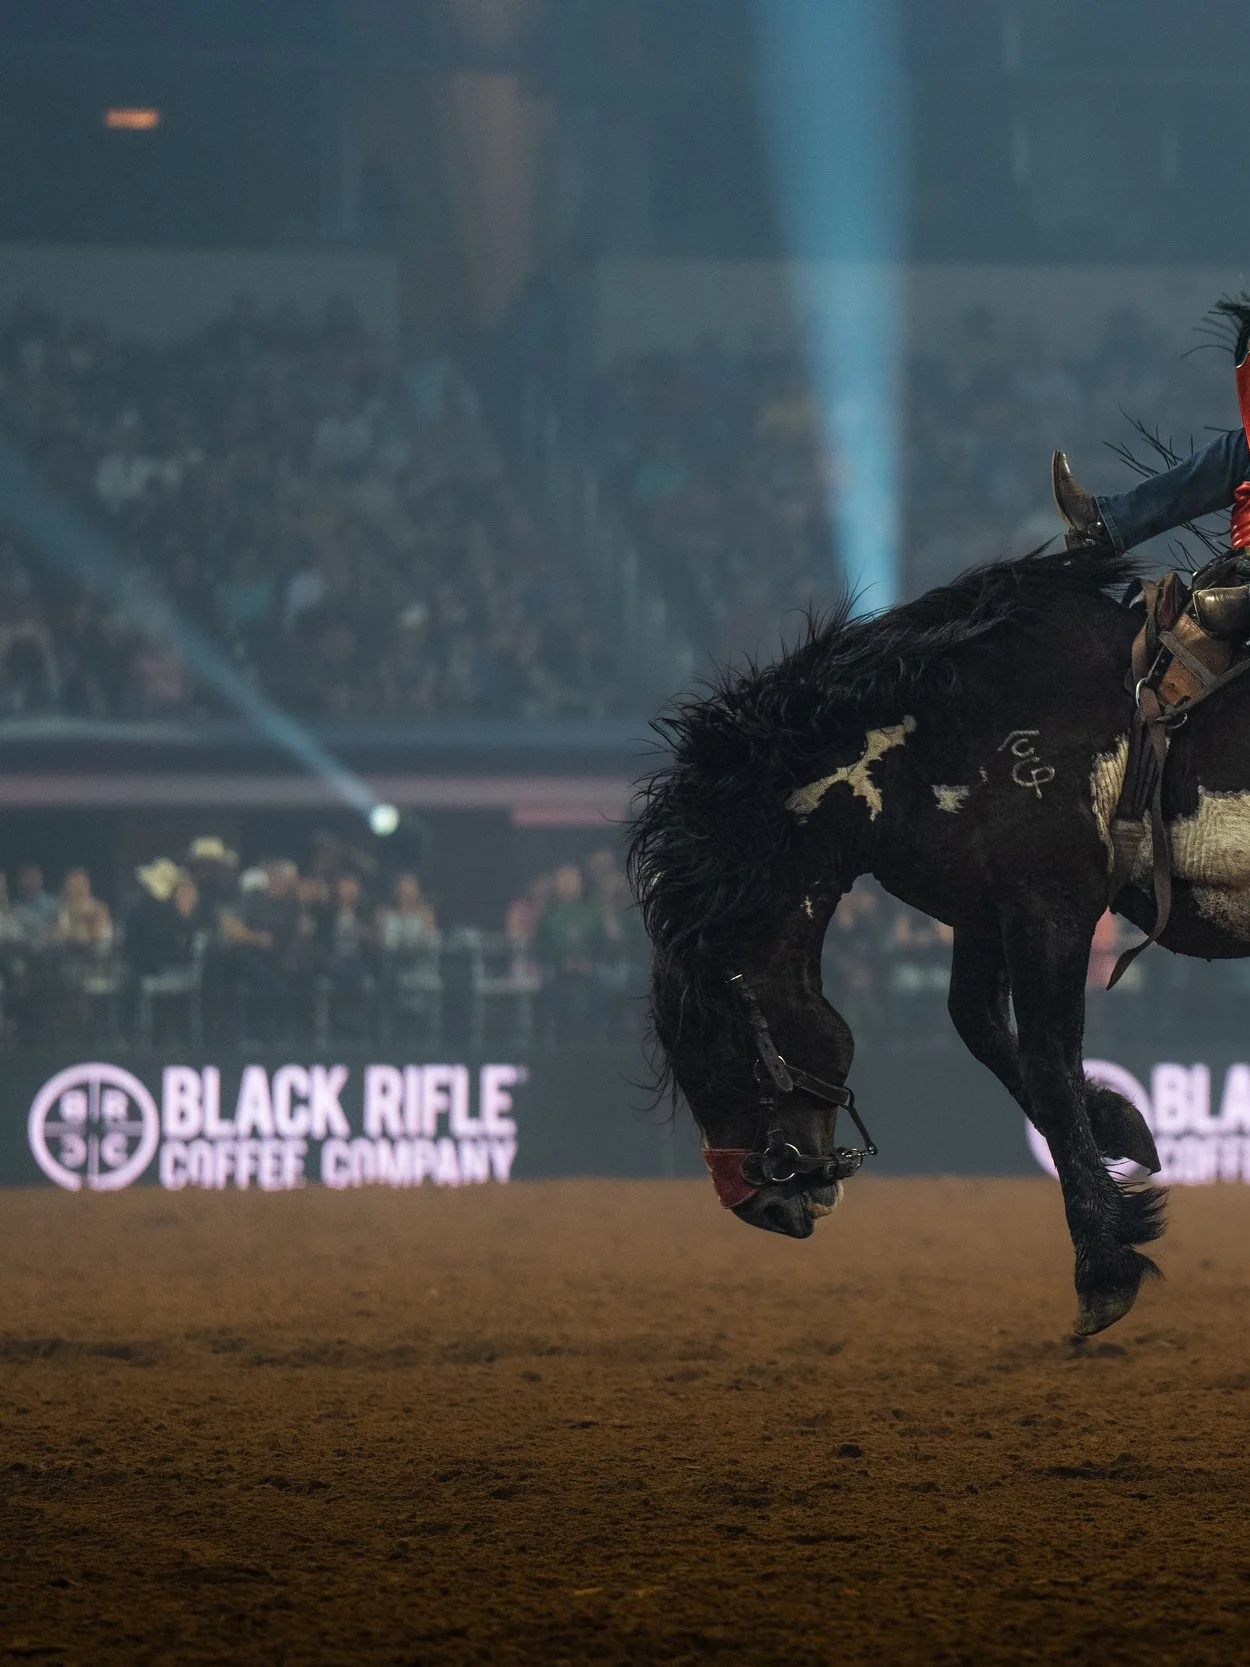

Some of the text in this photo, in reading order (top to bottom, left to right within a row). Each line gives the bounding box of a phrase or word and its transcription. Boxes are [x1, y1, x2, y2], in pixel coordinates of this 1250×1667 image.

[163, 1065, 517, 1137] BLACK RIFLE
[160, 1139, 517, 1189] COFFEE COMPANY
